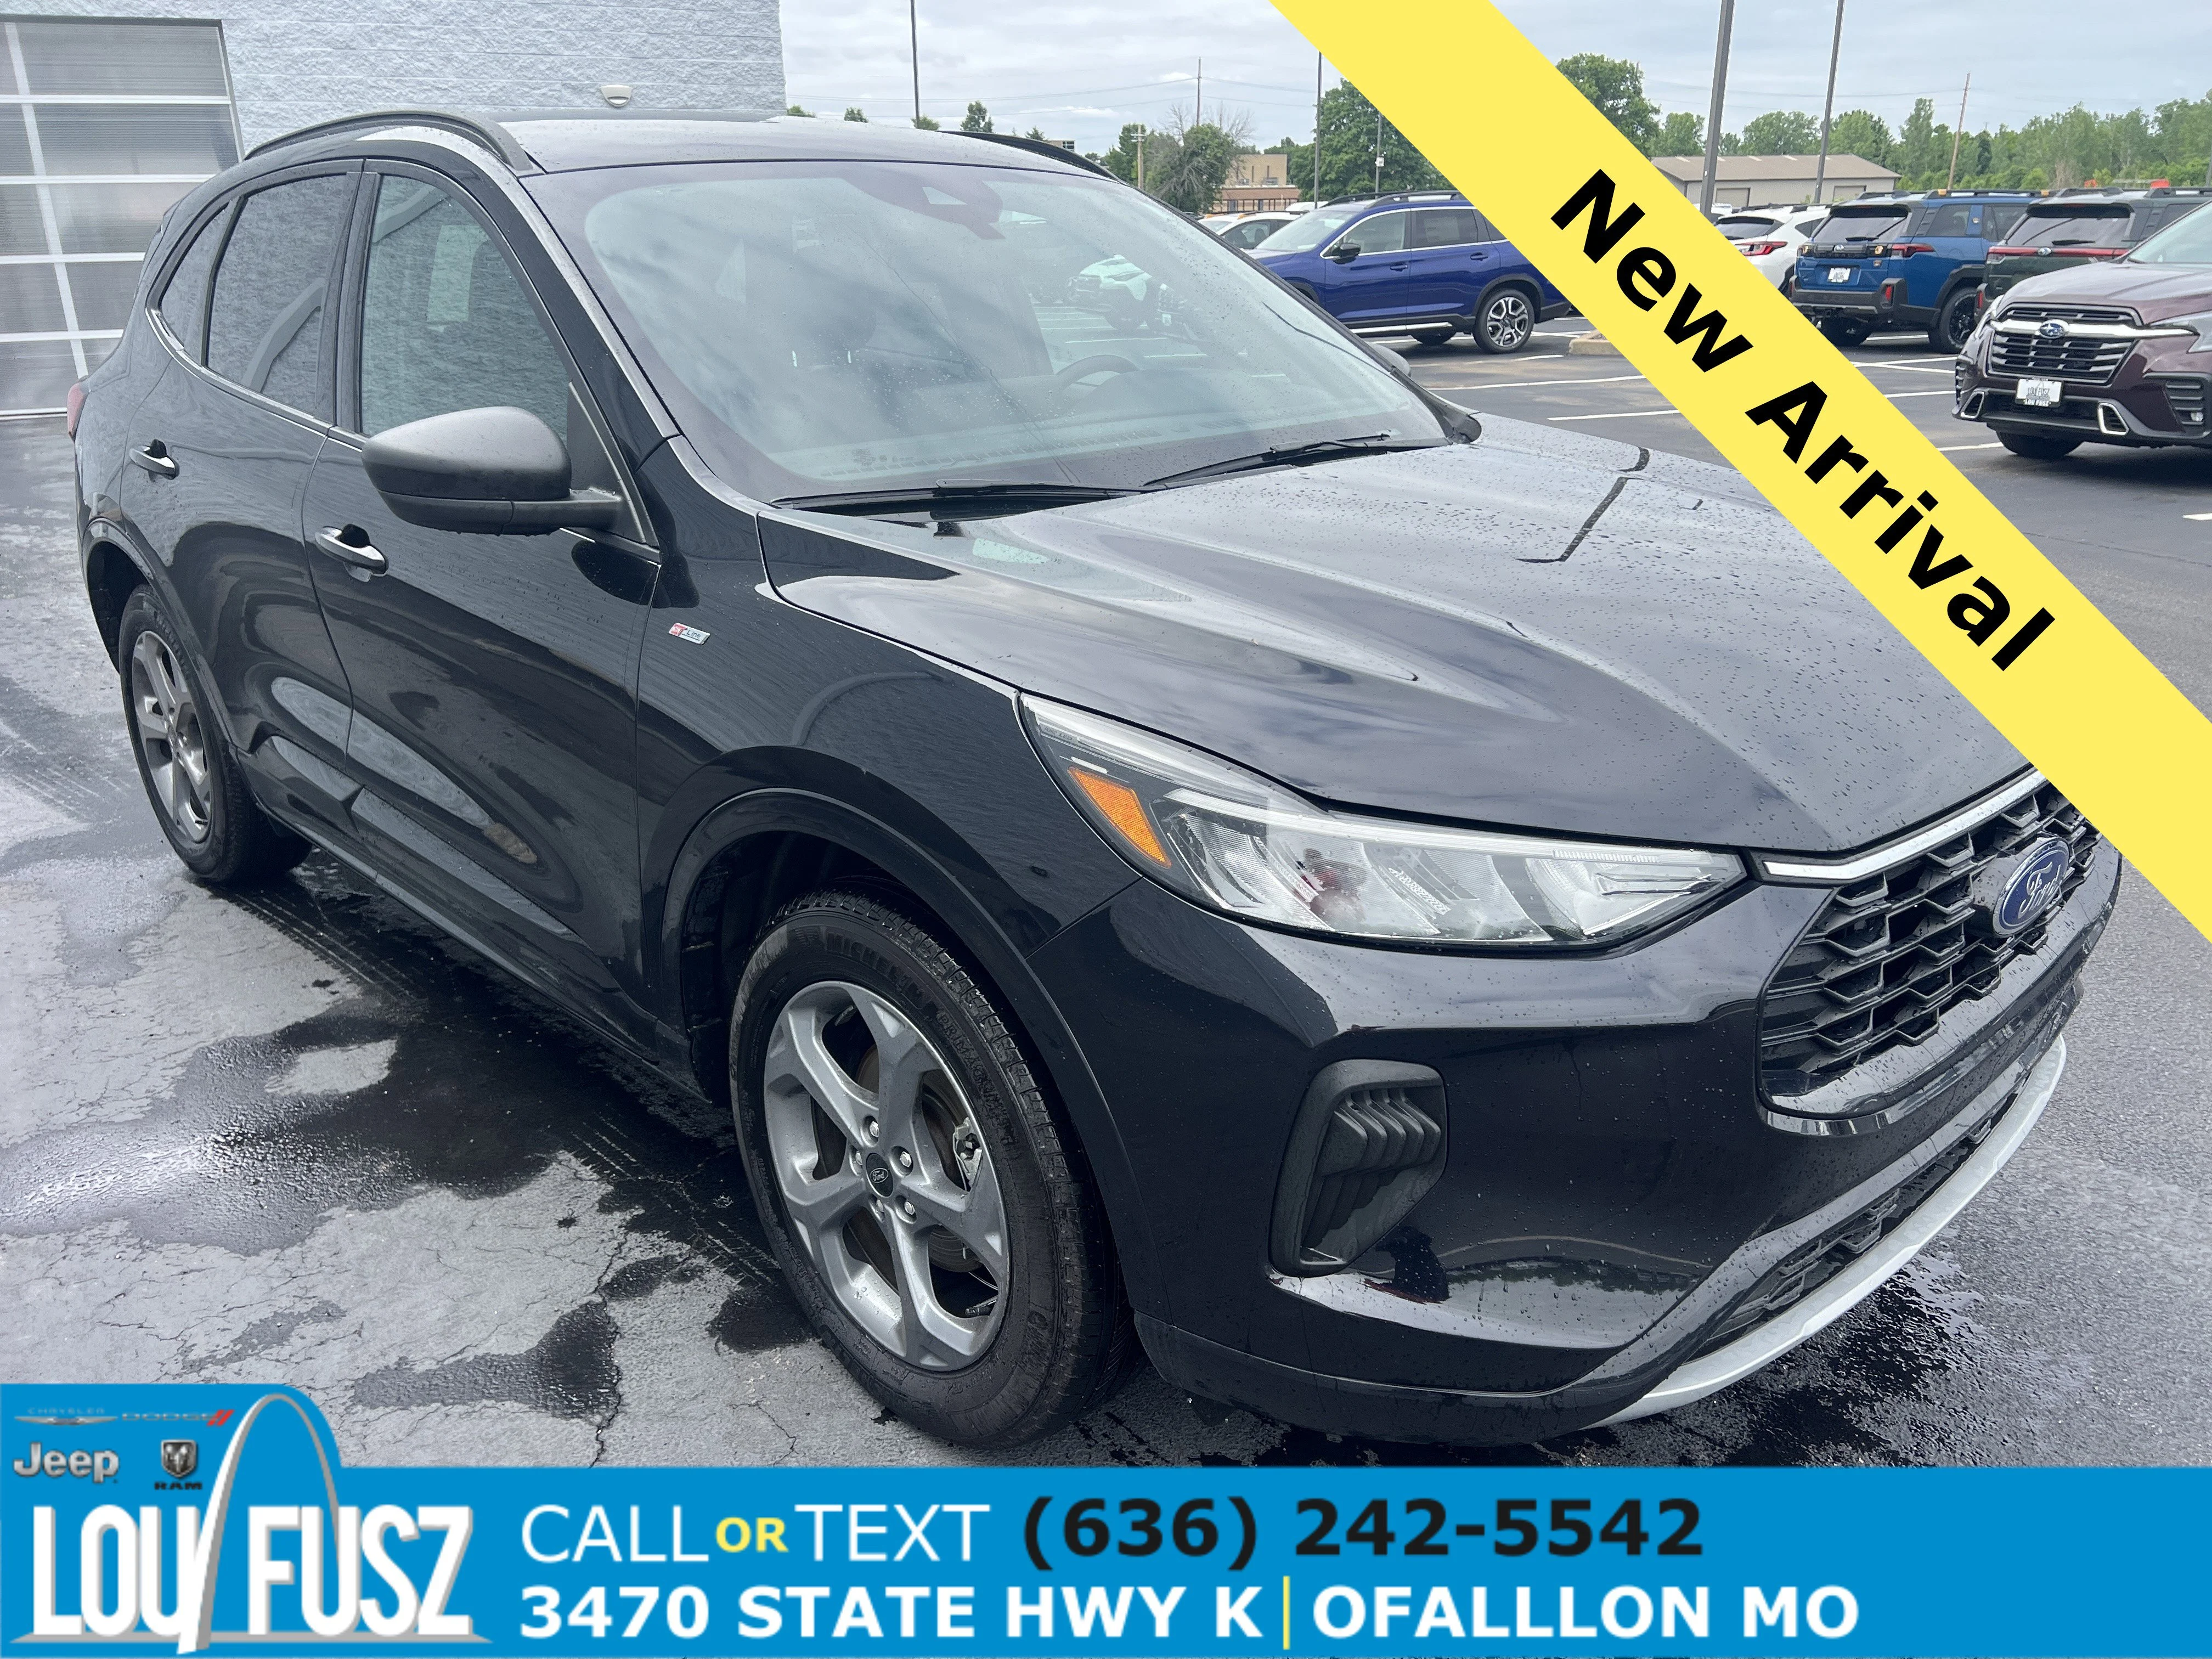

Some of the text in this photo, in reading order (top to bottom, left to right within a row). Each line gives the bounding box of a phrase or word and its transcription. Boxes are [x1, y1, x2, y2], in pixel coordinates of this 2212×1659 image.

[2038, 387, 2050, 396] FUSZ
[2018, 861, 2063, 919] Ford
[873, 1170, 885, 1181] Ford
